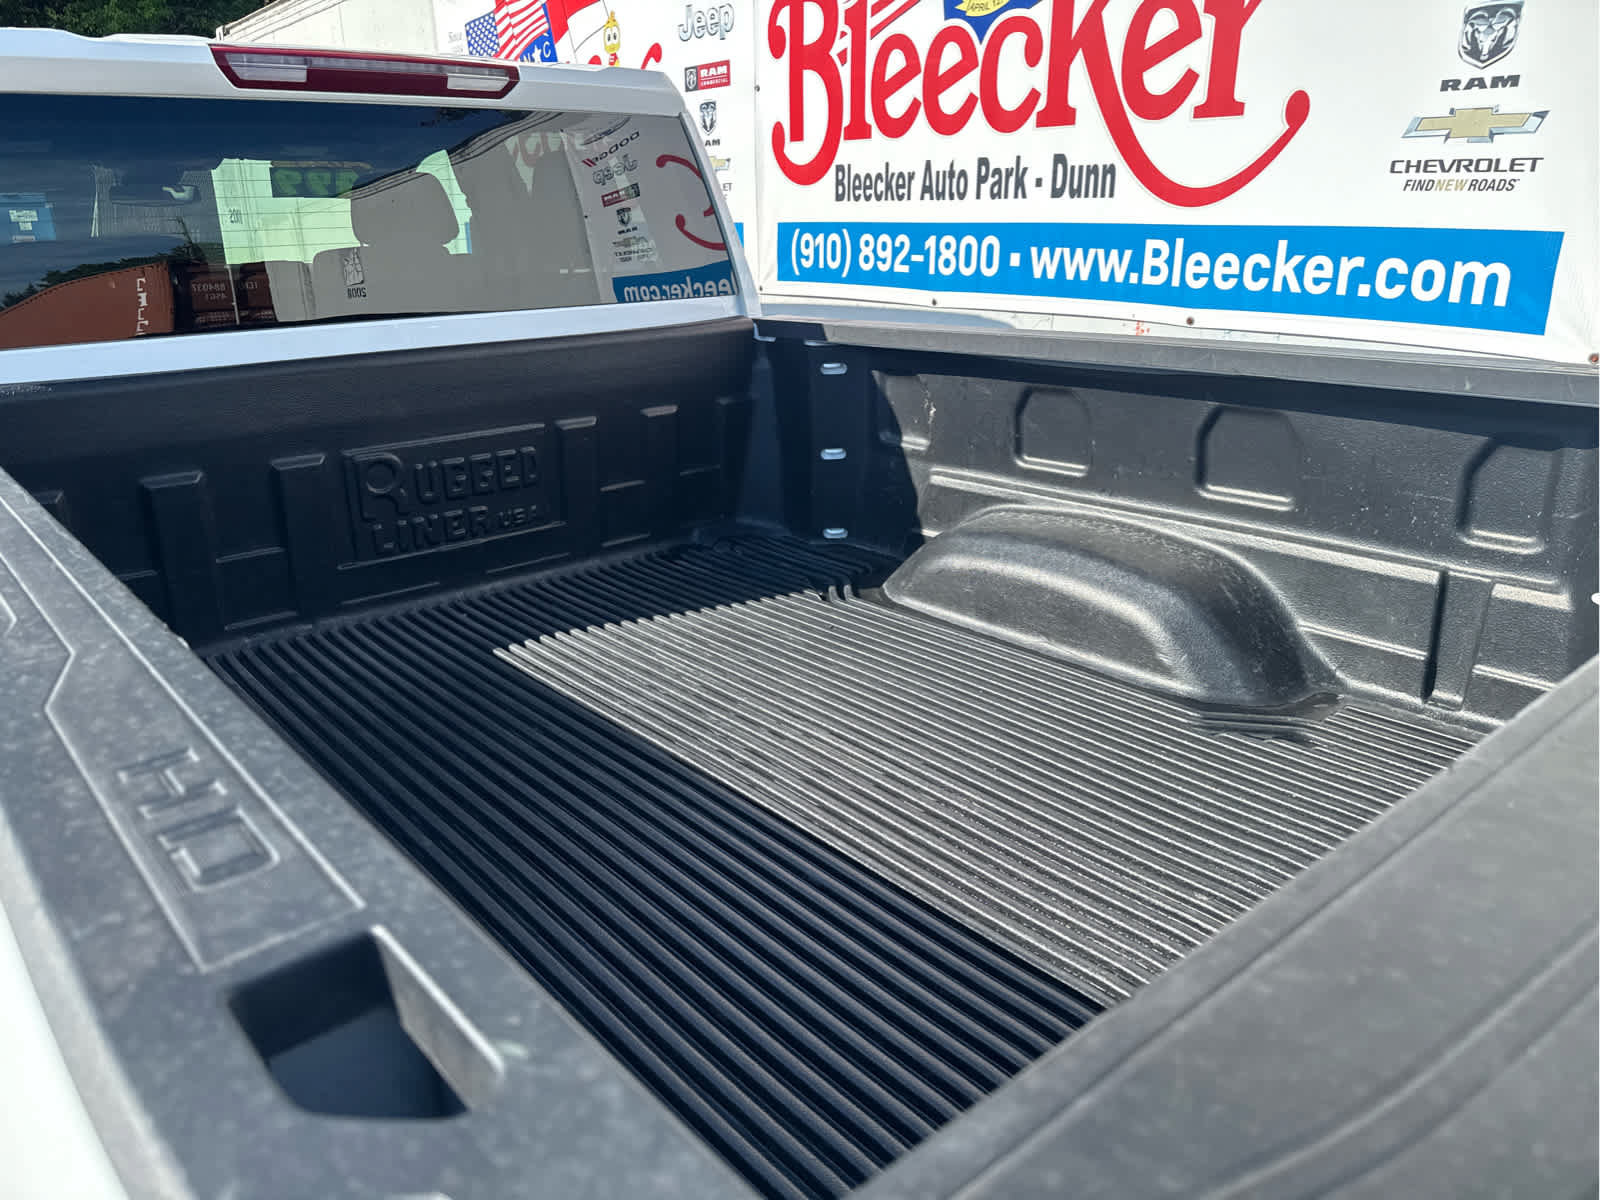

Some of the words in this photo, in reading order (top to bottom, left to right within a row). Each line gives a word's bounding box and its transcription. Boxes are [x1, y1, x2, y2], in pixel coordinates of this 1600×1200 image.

[677, 3, 734, 42] Jeep
[700, 65, 728, 78] RAM
[1440, 74, 1521, 92] RAM
[768, 0, 1310, 207] Bleecker
[704, 138, 720, 147] AM
[1389, 157, 1544, 174] CHEVROLET
[834, 161, 915, 202] Bleecker
[920, 159, 969, 201] Auto
[975, 155, 1029, 200] Park
[1050, 153, 1117, 199] Dunn
[1403, 178, 1435, 192] FIND
[1435, 178, 1469, 192] NEW
[1467, 178, 1517, 192] ROADS
[791, 228, 851, 278] (910)
[858, 233, 1001, 278] 892-1800
[1030, 237, 1512, 307] www.Bleecker.com
